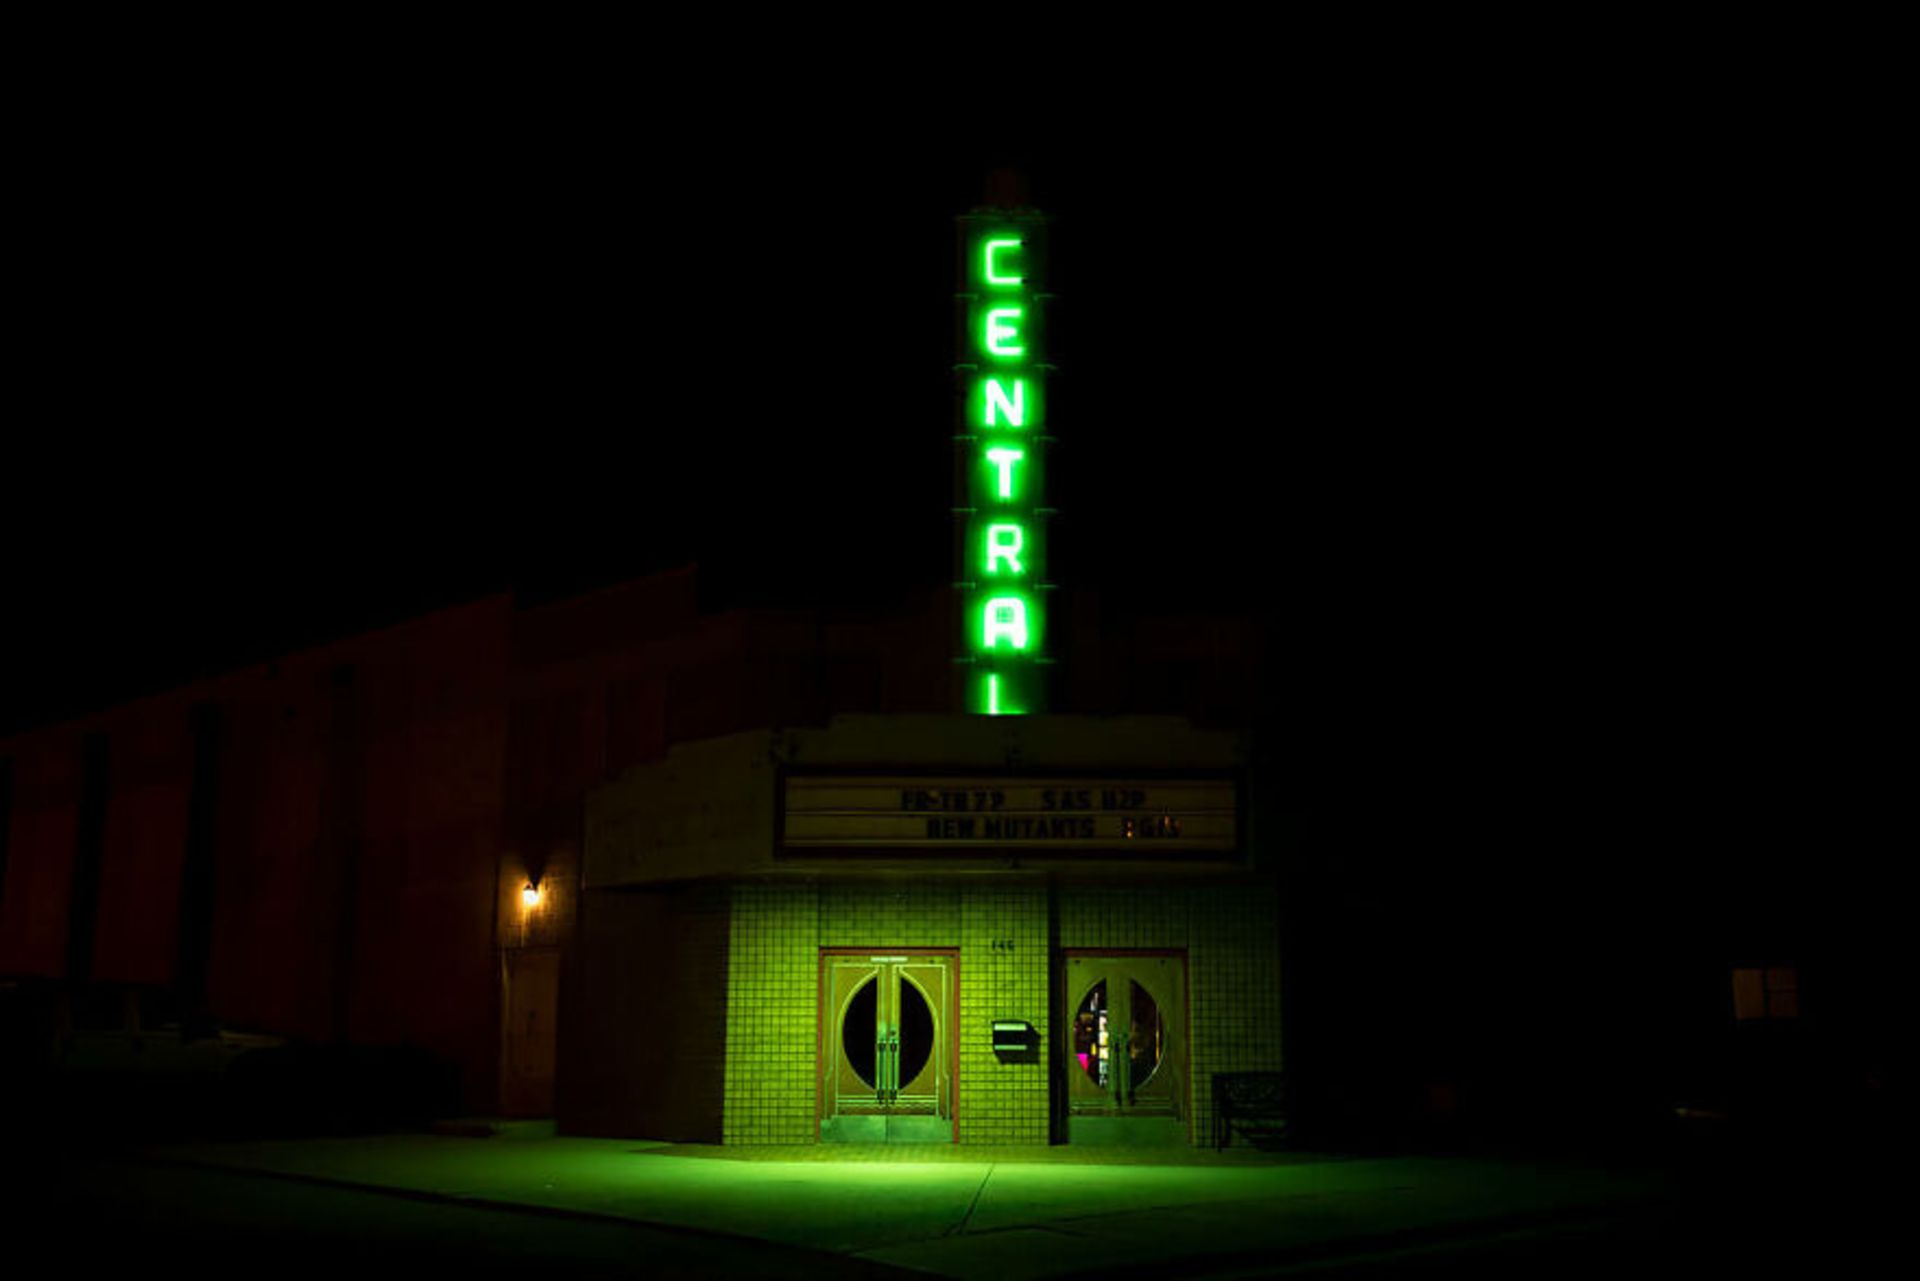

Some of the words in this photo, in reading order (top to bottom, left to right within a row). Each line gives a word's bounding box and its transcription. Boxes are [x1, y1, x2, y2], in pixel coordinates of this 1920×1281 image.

[983, 238, 1028, 715] CENTRAL
[927, 818, 975, 839] NEW
[985, 818, 1095, 839] MUTANTS
